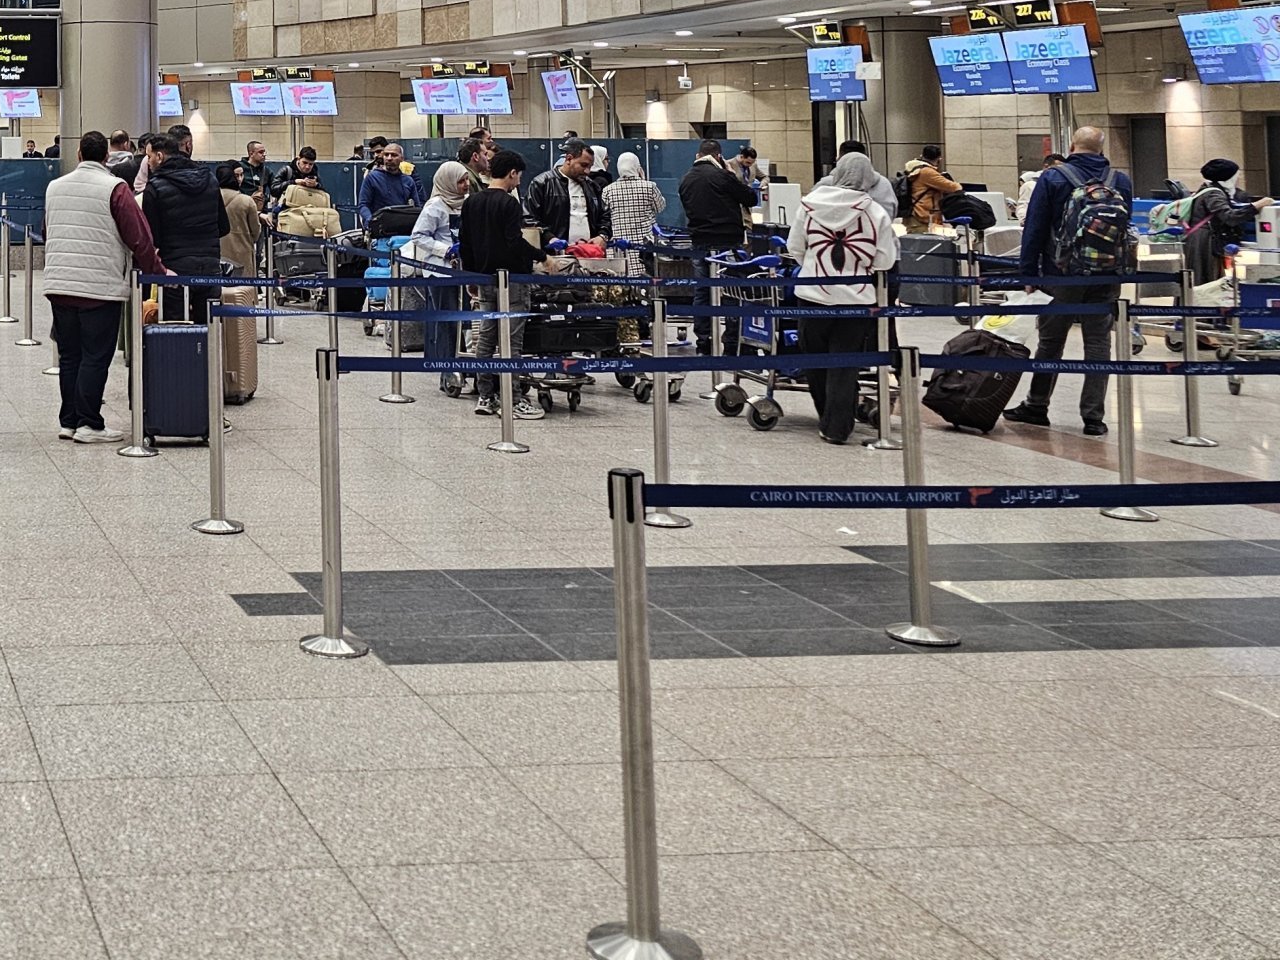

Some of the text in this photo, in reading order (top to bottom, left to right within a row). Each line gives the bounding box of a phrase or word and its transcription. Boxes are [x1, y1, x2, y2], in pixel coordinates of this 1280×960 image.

[1015, 4, 1032, 16] 227
[1054, 58, 1070, 66] Class
[424, 361, 450, 369] CAIRO
[452, 361, 520, 369] INTERNATIONAL
[1060, 363, 1124, 371] INTERNATIONAL
[750, 491, 961, 502] CAIRO INTERNATIONAL AIRPORT
[1030, 489, 1057, 503] القاهرة
[1059, 489, 1080, 503] مطار
